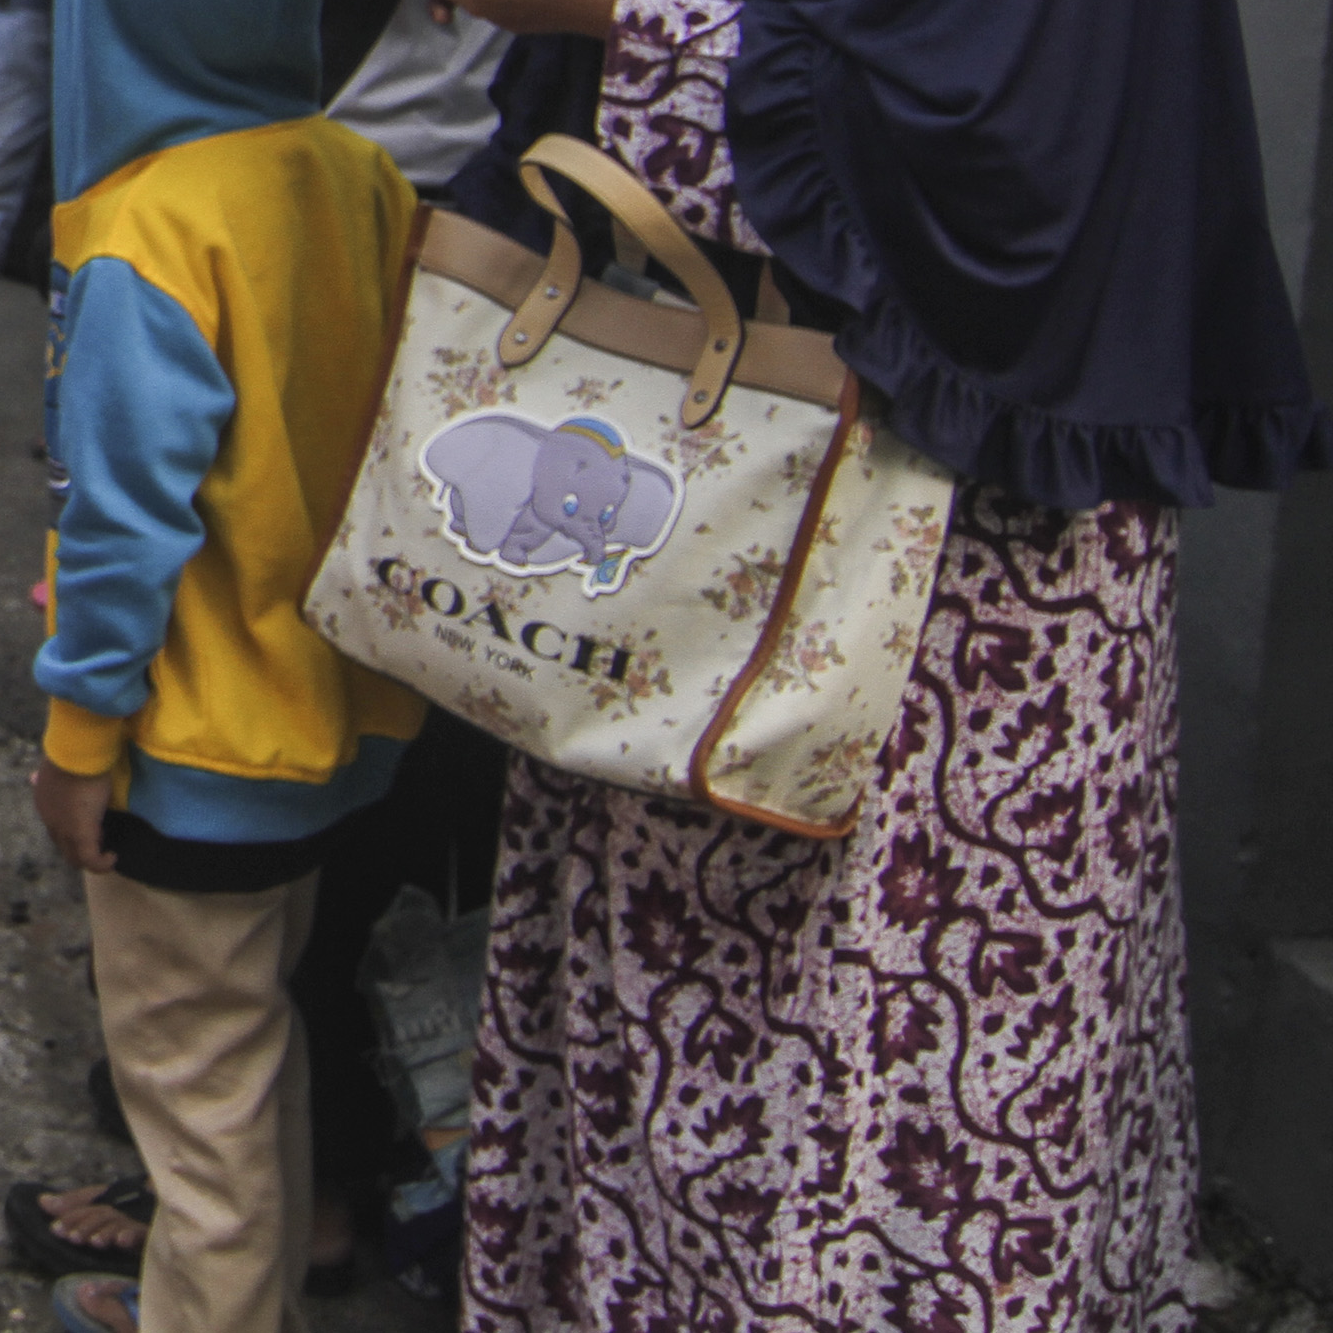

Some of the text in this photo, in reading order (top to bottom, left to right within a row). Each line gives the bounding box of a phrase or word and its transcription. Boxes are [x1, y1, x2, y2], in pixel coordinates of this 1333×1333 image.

[378, 557, 632, 682] COACH
[434, 623, 534, 681] NEW YORK
